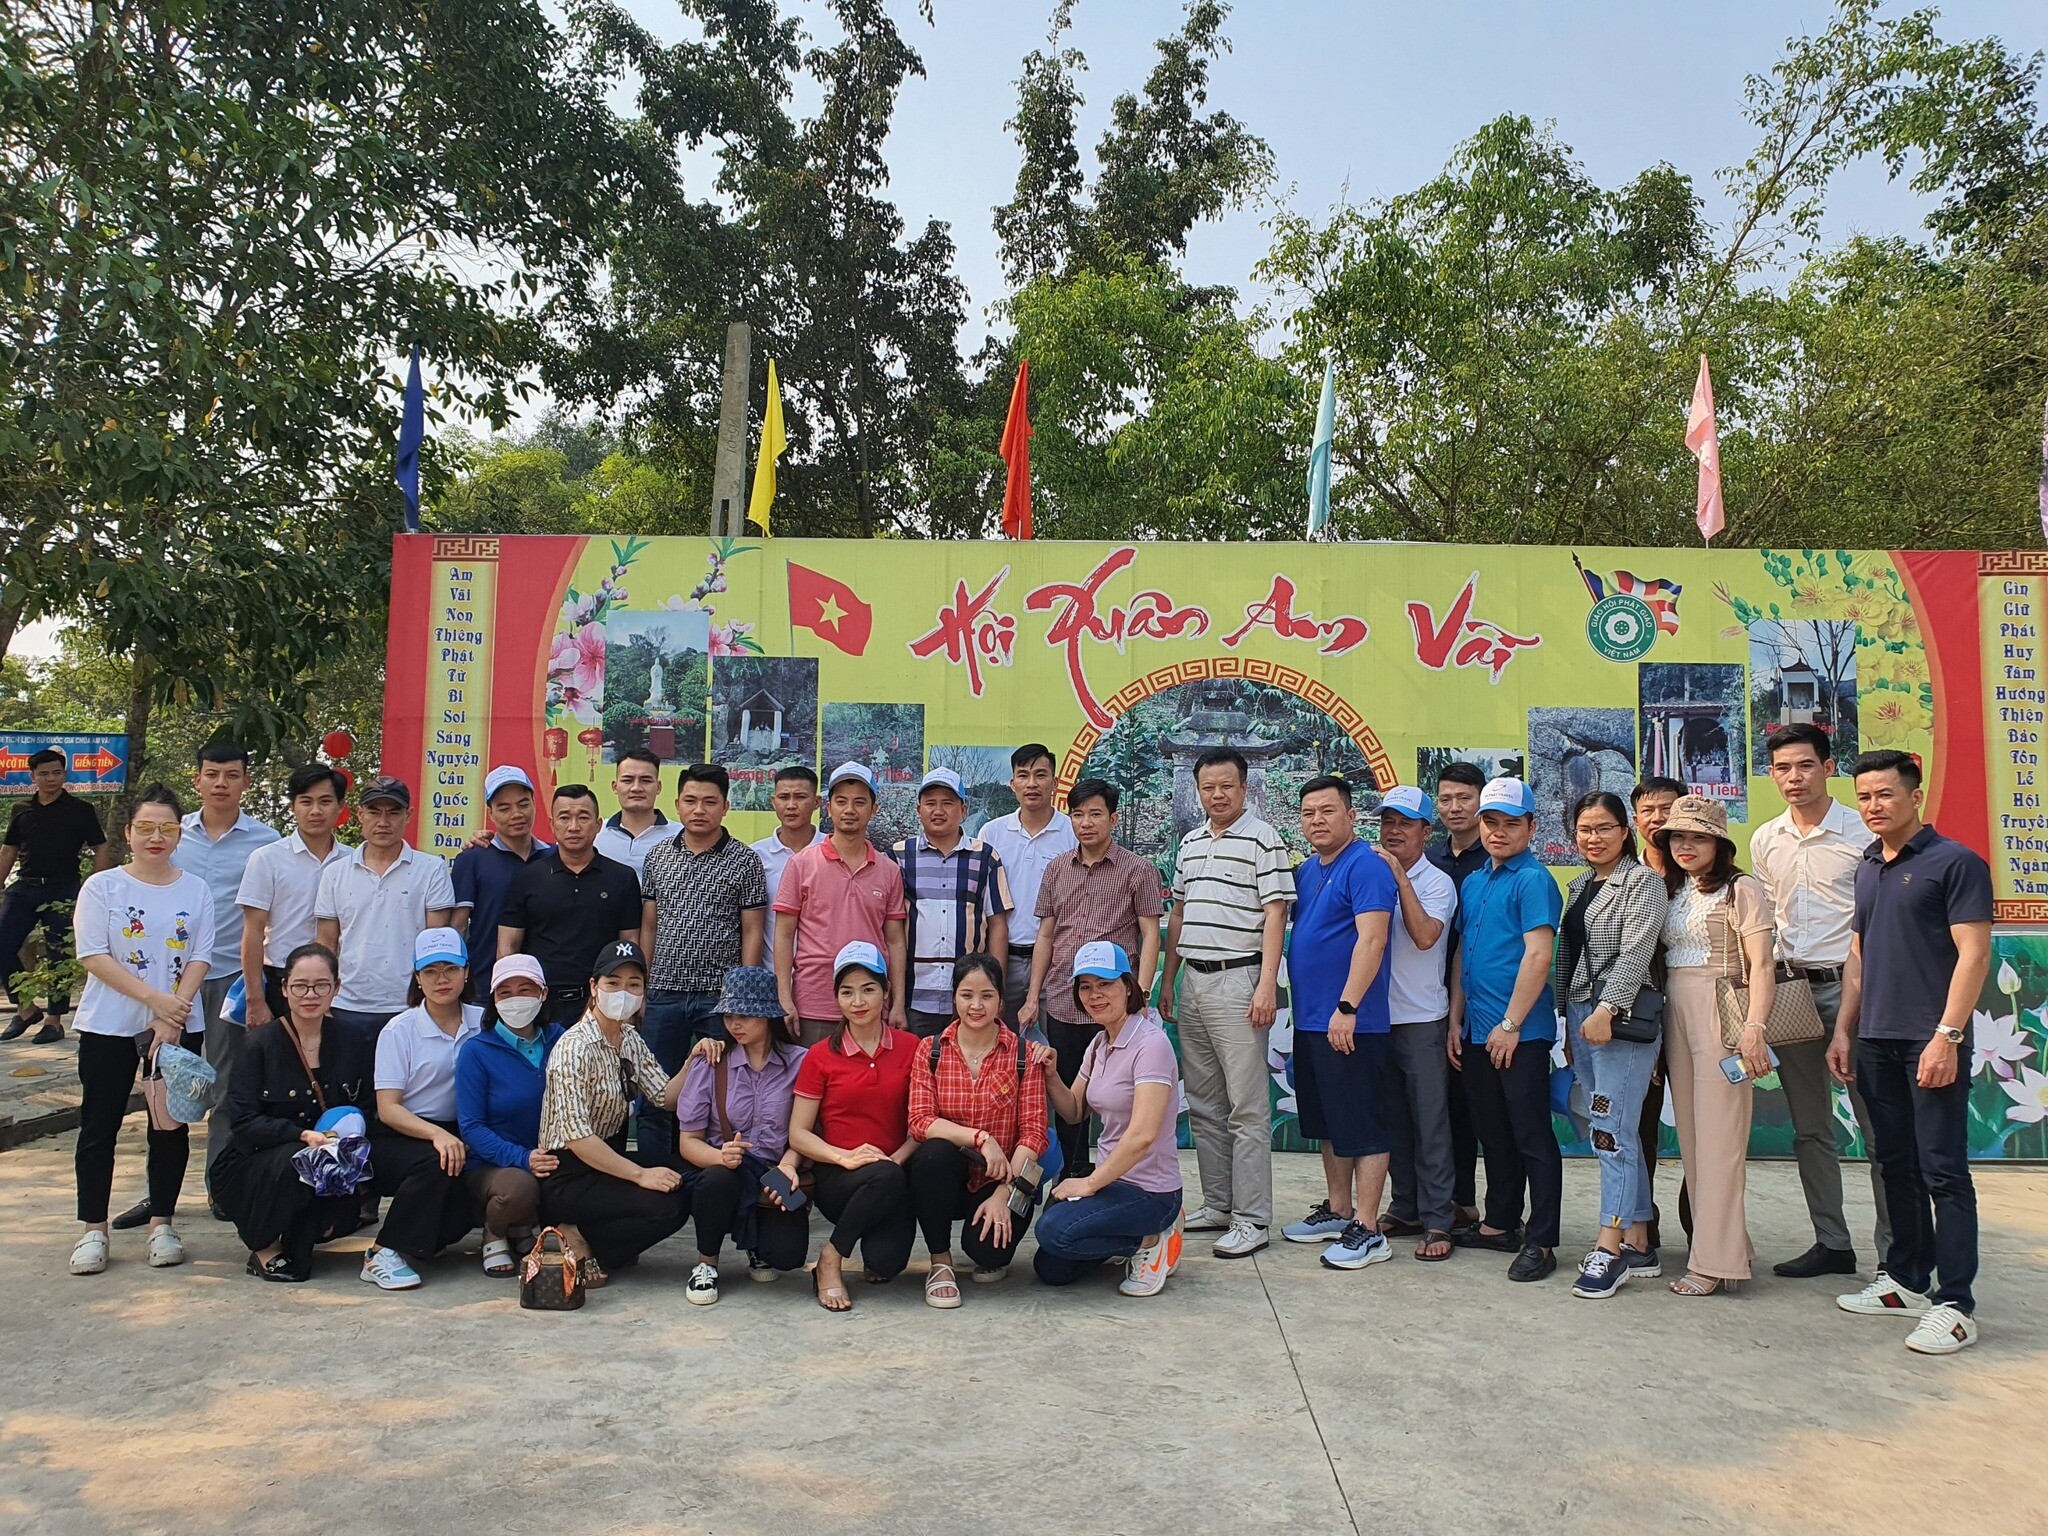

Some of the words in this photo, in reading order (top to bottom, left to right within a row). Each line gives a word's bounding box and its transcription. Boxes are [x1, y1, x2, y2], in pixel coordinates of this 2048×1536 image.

[450, 567, 473, 582] Am
[450, 587, 471, 601] Vãi
[2003, 581, 2028, 597] Gìn
[446, 608, 473, 622] Non
[2003, 602, 2030, 616] Giữ
[1591, 609, 1603, 628] GIÁO
[1639, 609, 1653, 628] GIÁO
[434, 628, 483, 645] Thiêng
[1999, 623, 2036, 638] Phát
[909, 566, 1015, 696] Hội
[1026, 548, 1209, 729] Xuân
[1222, 576, 1368, 655] Am
[441, 648, 474, 664] Phật
[1623, 647, 1641, 658] NAM
[2003, 644, 2034, 661] Huy
[447, 668, 466, 682] Từ
[2004, 665, 2035, 681] Tâm
[448, 689, 463, 702] Bi
[1995, 686, 2046, 704] Hướng
[443, 709, 466, 723] Soi
[1999, 707, 2044, 724] Thiện
[436, 730, 471, 747] Sáng
[2007, 728, 2038, 743] Bảo
[426, 750, 479, 767] Nguyện
[2009, 750, 2038, 765] Tồn
[438, 771, 465, 785] Cầu
[2016, 770, 2034, 785] Lễ
[433, 791, 469, 808] Quốc
[2013, 792, 2040, 809] Hội
[433, 813, 465, 828] Thái
[2013, 878, 2048, 896] Năm
